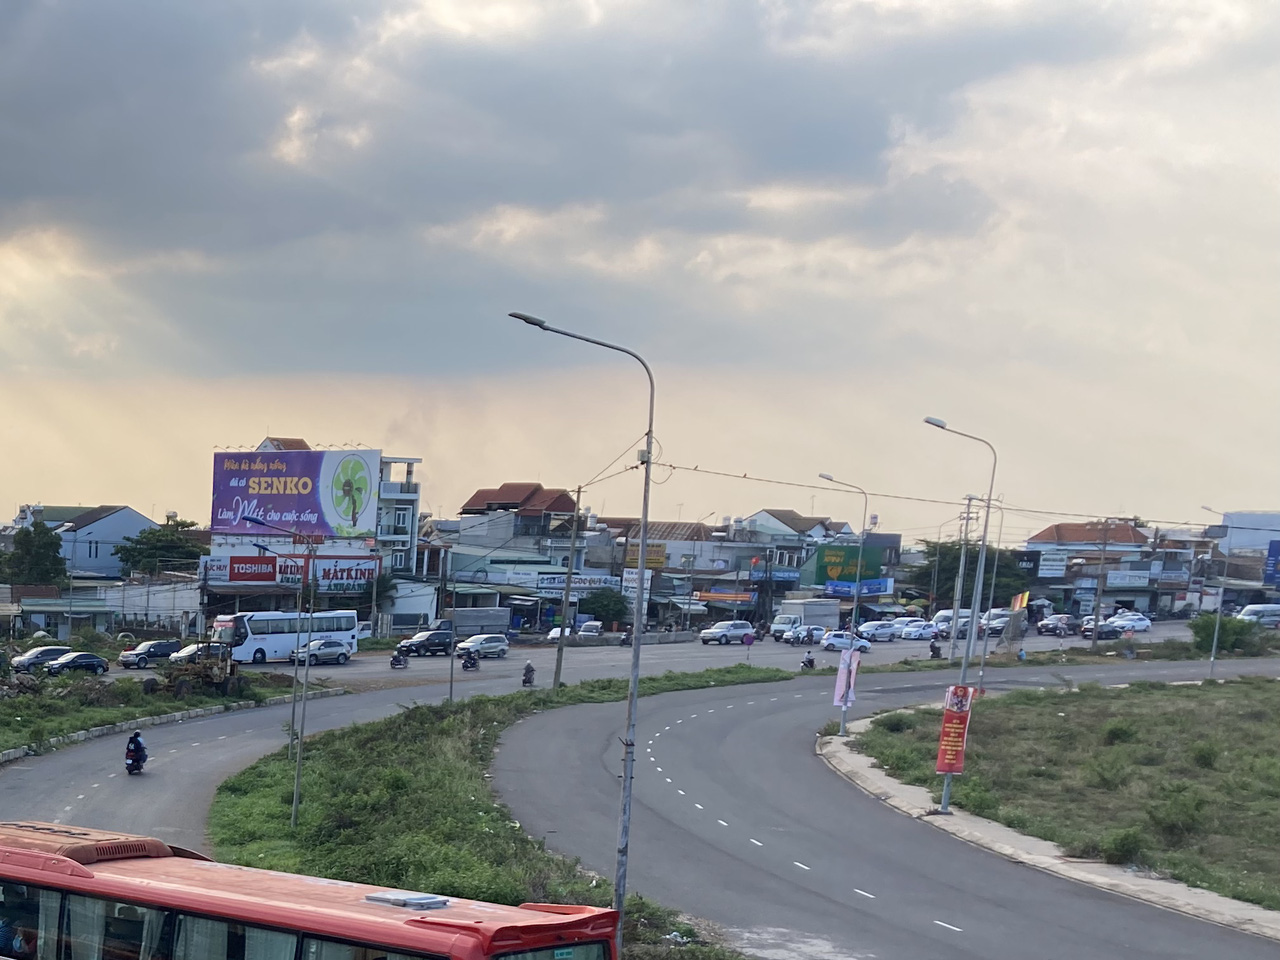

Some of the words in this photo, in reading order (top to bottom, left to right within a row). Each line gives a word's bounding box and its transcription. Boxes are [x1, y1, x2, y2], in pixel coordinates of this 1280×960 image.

[249, 477, 313, 494] SENKO
[267, 510, 281, 521] cho
[233, 563, 273, 573] TOSHIBA
